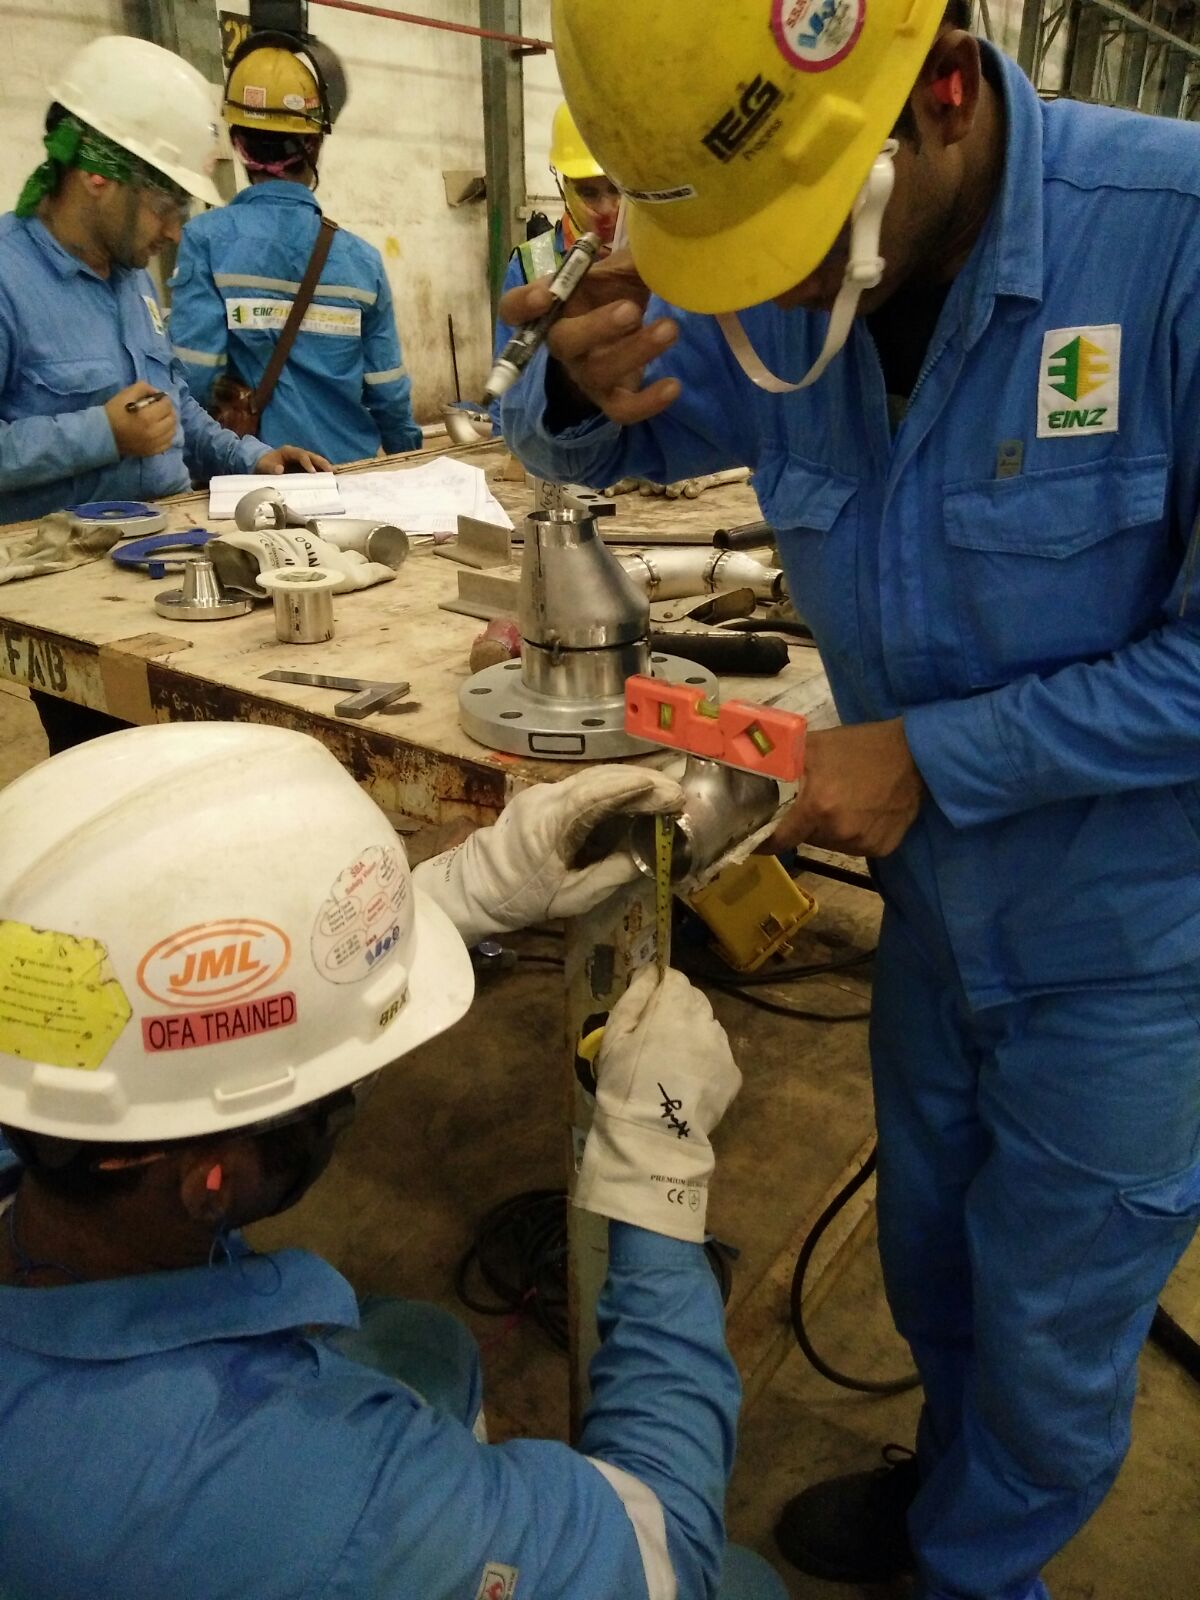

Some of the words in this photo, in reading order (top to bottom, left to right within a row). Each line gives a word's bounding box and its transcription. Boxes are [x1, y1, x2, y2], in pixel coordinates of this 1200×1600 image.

[1047, 407, 1108, 430] EINZ
[169, 940, 260, 987] JML
[148, 1017, 196, 1050] OFA
[200, 995, 295, 1041] TRAINED
[650, 1173, 687, 1186] PREMIUM
[667, 1188, 686, 1205] CE
